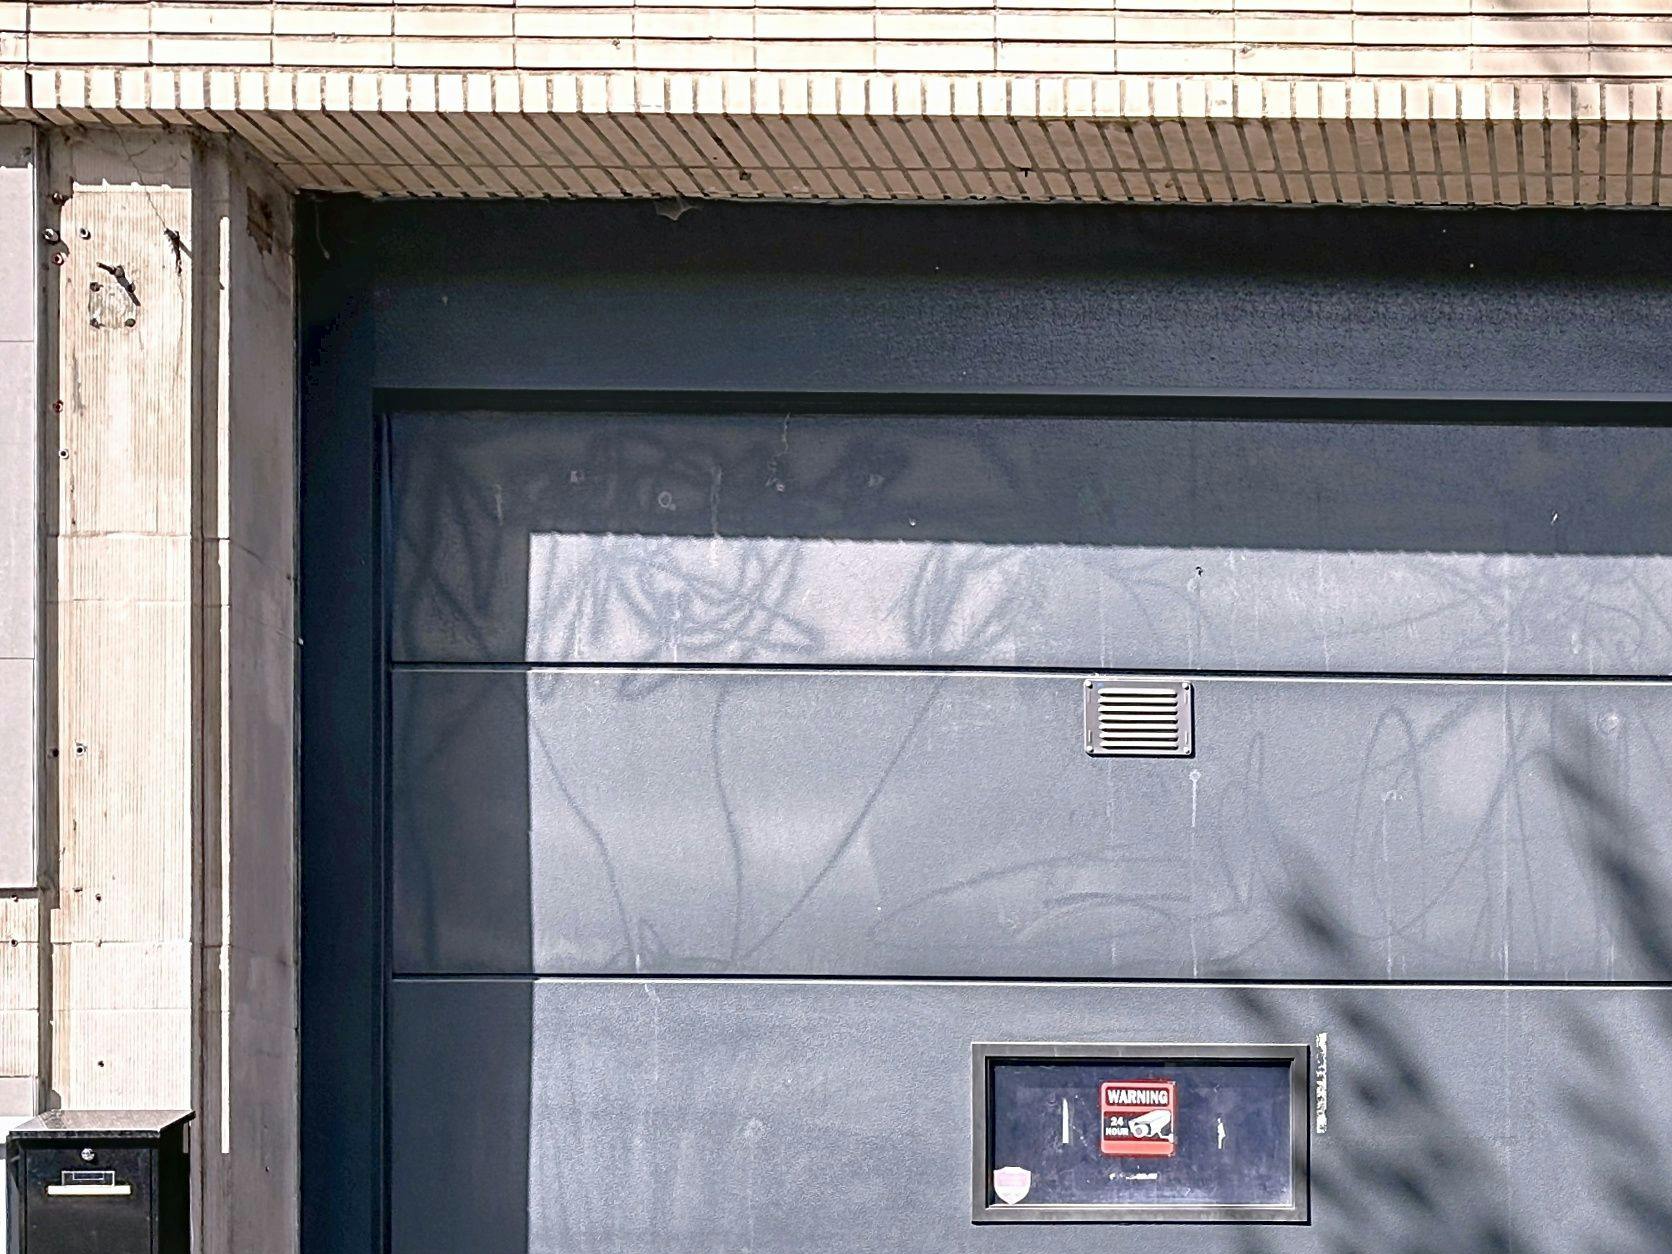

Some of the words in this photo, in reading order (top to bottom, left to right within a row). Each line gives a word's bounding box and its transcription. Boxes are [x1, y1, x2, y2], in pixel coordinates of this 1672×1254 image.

[1107, 1089, 1168, 1105] WARNING
[1110, 1116, 1124, 1127] 24
[1105, 1127, 1129, 1136] HOUR
